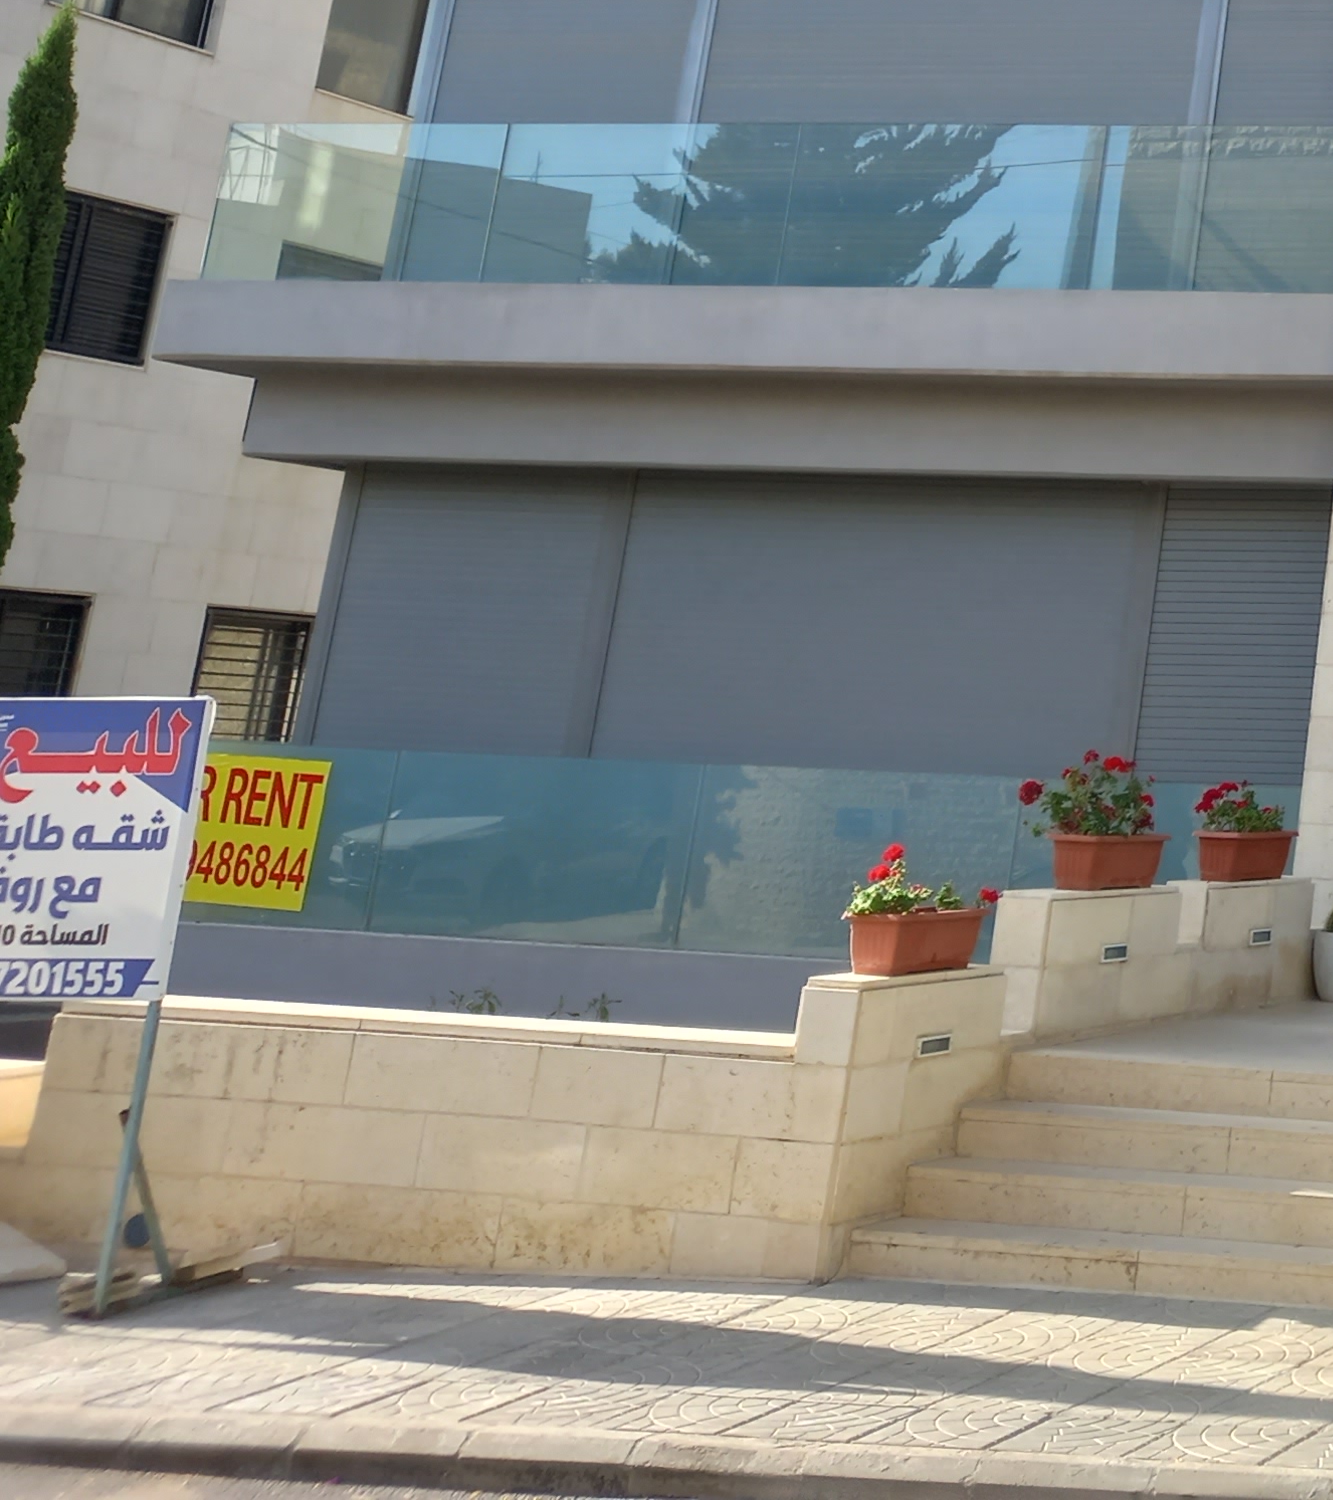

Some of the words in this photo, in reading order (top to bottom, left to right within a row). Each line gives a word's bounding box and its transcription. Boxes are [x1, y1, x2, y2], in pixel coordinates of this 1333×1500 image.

[0, 707, 192, 804] للبيع
[219, 767, 325, 830] RENT
[48, 875, 102, 919] مع
[20, 923, 110, 946] المساحة
